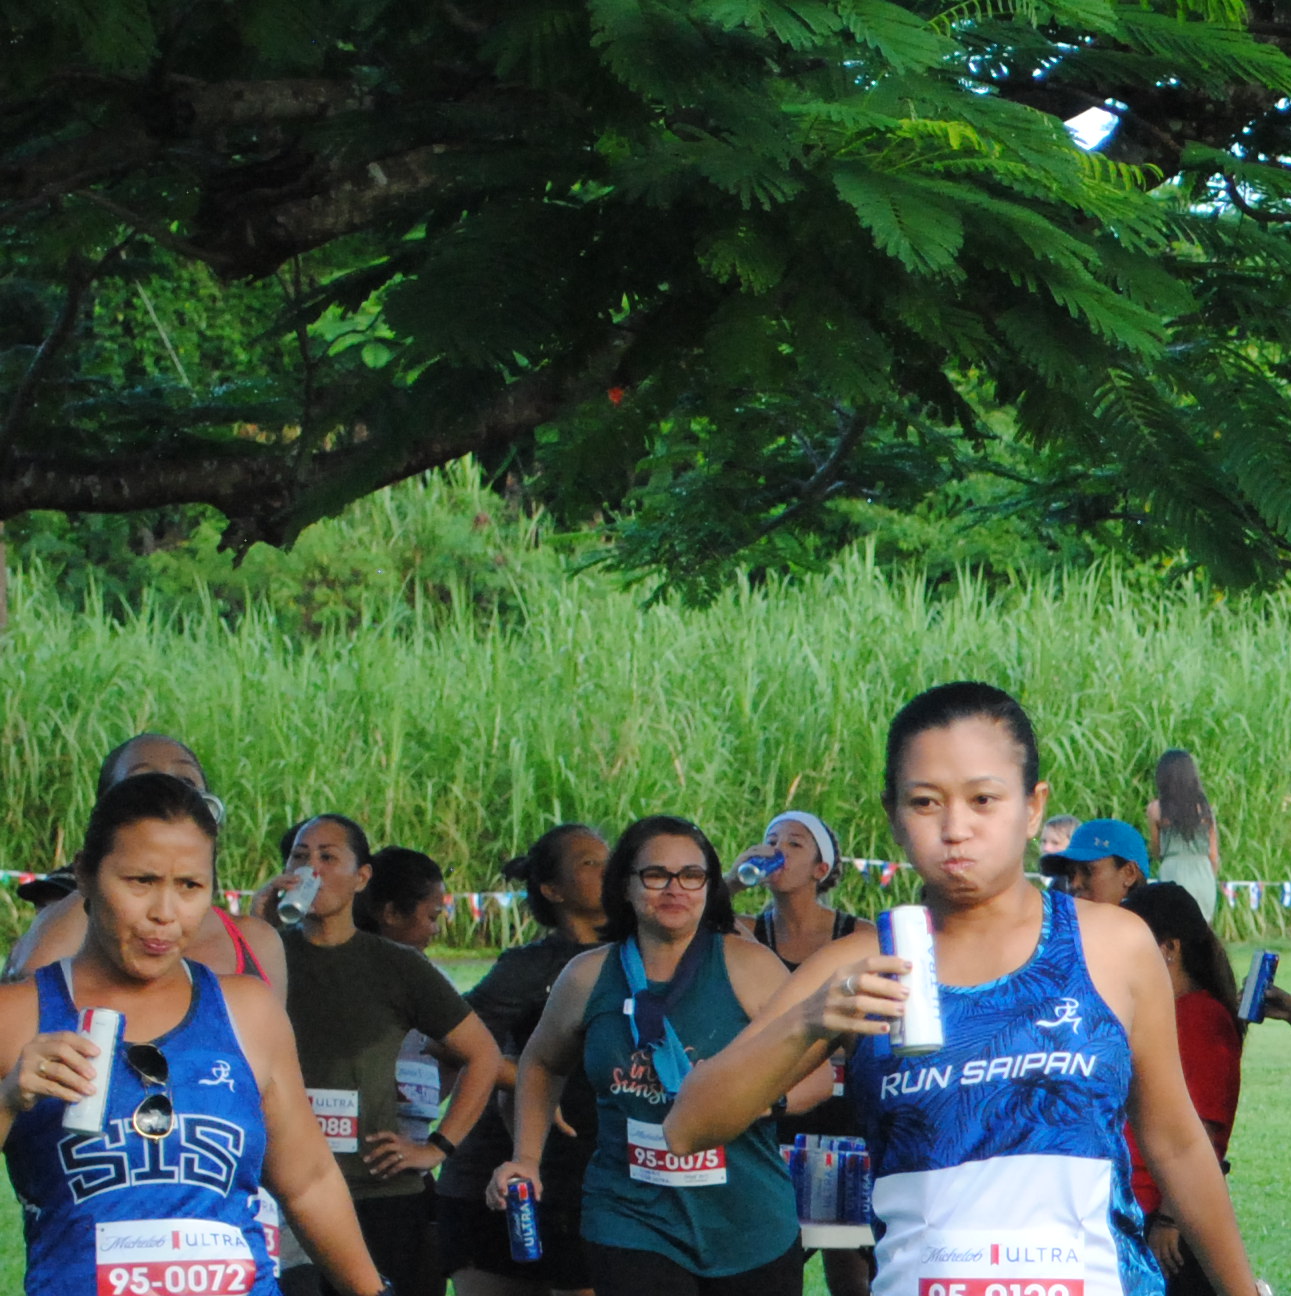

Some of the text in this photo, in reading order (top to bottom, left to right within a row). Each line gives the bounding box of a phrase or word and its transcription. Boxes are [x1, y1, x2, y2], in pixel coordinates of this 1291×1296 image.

[880, 1052, 1096, 1100] RUN SAIPAN
[316, 1098, 355, 1108] ULTRA
[634, 1147, 719, 1171] 95-0075
[520, 1202, 536, 1247] ULTRA
[101, 1232, 246, 1252] Michelob ULTRA
[921, 1246, 1079, 1264] Michelob ULTRA
[108, 1263, 247, 1296] 95-0072
